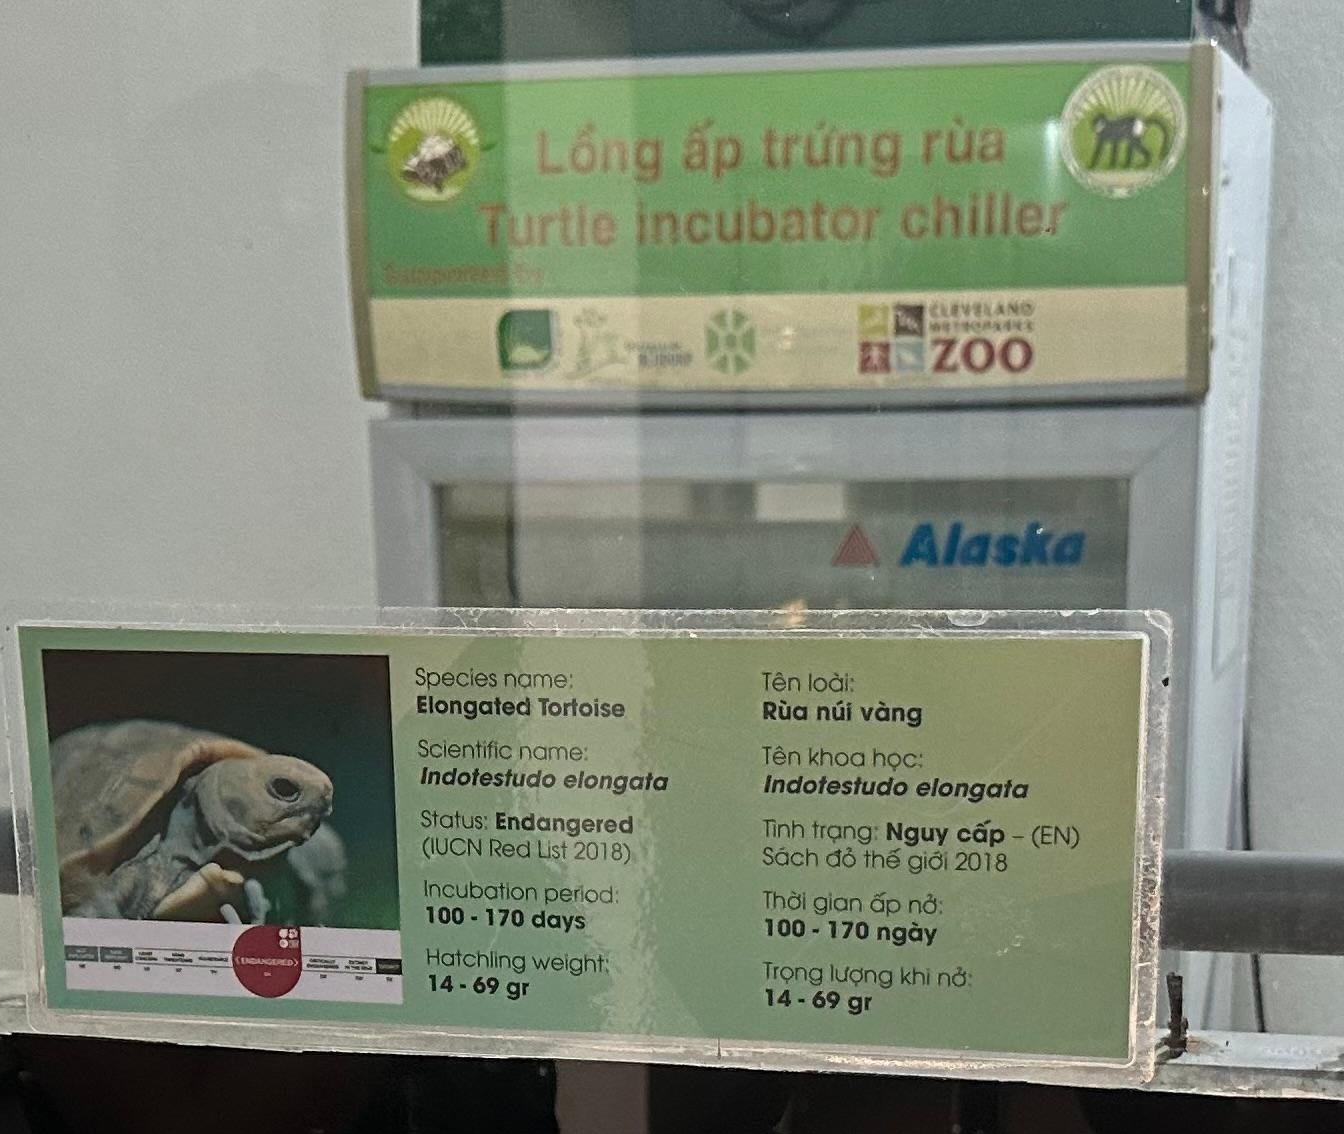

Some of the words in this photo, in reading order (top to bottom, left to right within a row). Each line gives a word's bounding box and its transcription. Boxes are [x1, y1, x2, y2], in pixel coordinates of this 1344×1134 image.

[921, 119, 1006, 166] rùa
[479, 202, 618, 249] Turtle
[636, 198, 882, 245] incubator
[900, 190, 1069, 240] chiller
[929, 303, 1035, 317] CLEVELAND
[931, 336, 1034, 373] ZOO
[899, 520, 1086, 567] Alaska
[415, 667, 497, 690] Species
[504, 671, 574, 692] name:
[762, 672, 800, 692] Tên
[808, 673, 854, 693] loài:
[416, 696, 531, 720] Elongated
[538, 698, 625, 718] Tortoise
[763, 701, 808, 721] Rùa
[861, 702, 923, 727] vàng
[418, 739, 512, 761] Scientific
[519, 742, 588, 762] name:
[762, 747, 800, 766] Tên
[808, 748, 865, 767] khoa
[872, 749, 923, 771] học:
[420, 767, 556, 789] Indotestudo
[564, 771, 669, 795] elongata
[764, 775, 908, 796] Indotestudo
[916, 778, 1029, 803] elongata
[420, 810, 488, 831] Status:
[495, 812, 634, 838] Endangered
[763, 819, 804, 840] Tình
[812, 821, 879, 843] trạng:
[886, 822, 948, 847] Nguy
[957, 820, 1005, 847] cấp
[1031, 825, 1080, 849] (EN)
[422, 838, 482, 859] (IUCN
[489, 839, 531, 859] Red
[538, 840, 567, 859] List
[574, 842, 631, 865] 2018)
[762, 849, 818, 868] Sách
[826, 849, 856, 868] đỏ
[864, 849, 900, 870] thế
[908, 850, 948, 874] giới
[955, 851, 1008, 872] 2018
[424, 880, 537, 902] Incubation
[544, 885, 619, 905] period:
[763, 891, 806, 911] Thời
[813, 893, 862, 914] gian
[870, 891, 901, 916] ấp
[908, 896, 943, 915] nở:
[426, 906, 464, 925] 100
[486, 909, 524, 927] 170
[532, 911, 585, 932] days
[766, 919, 805, 938] 100
[828, 921, 869, 940] 170
[877, 924, 937, 946] ngày
[427, 948, 526, 974] Hatchling
[534, 954, 610, 975] weight:
[428, 975, 454, 993] 14
[473, 977, 499, 995] 69
[507, 980, 530, 1001] gr
[763, 962, 823, 985] Trọng
[830, 964, 892, 988] lượng
[900, 968, 931, 985] khi
[937, 967, 972, 988] nở:
[766, 989, 791, 1007] 14
[812, 991, 840, 1009] 69
[848, 994, 872, 1015] gr
